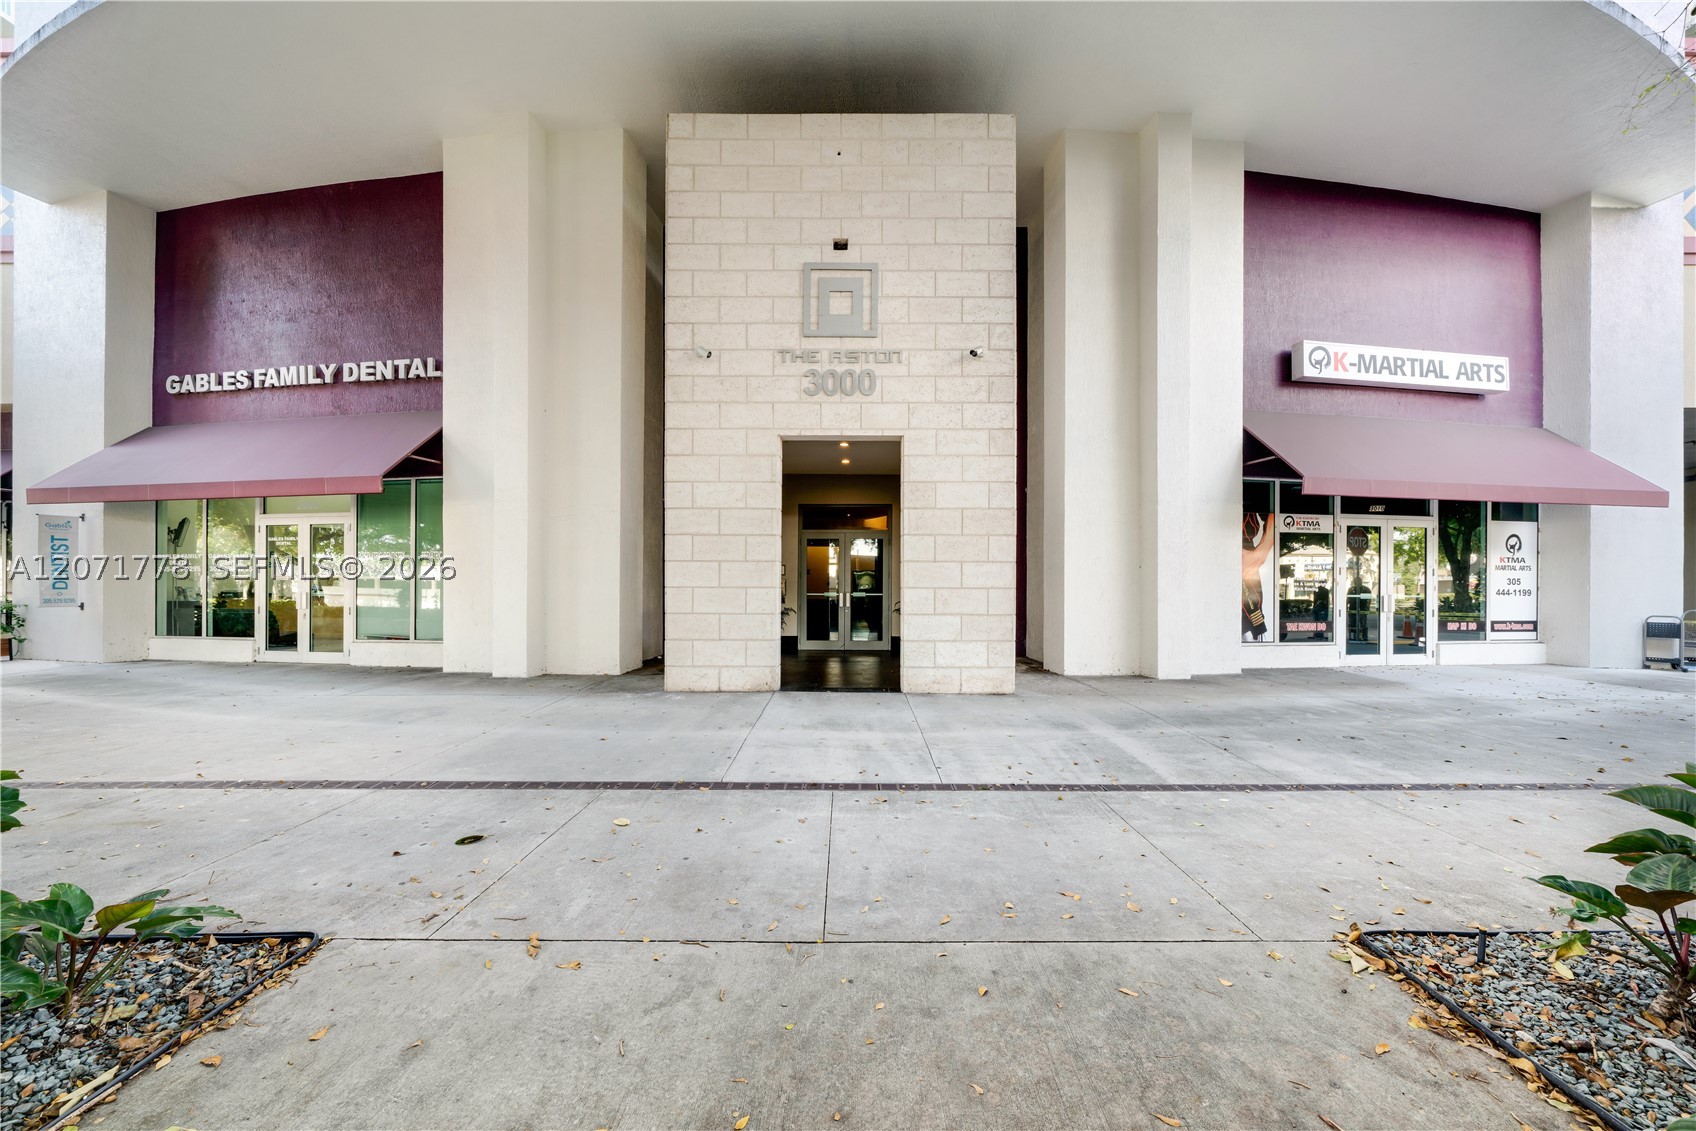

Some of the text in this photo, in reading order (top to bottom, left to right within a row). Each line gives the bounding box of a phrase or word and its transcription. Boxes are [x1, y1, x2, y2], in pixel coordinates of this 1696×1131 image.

[777, 349, 903, 364] THE ASTON
[1333, 351, 1506, 384] K-MARTIAL ARTS
[165, 357, 443, 395] GABLES FAMILY DENTAL
[803, 368, 877, 397] 3000
[1506, 578, 1522, 586] 305
[1495, 589, 1532, 597] 444-1199
[1286, 622, 1327, 632] TAE KWON DO
[1447, 622, 1477, 631] HAP KI DO
